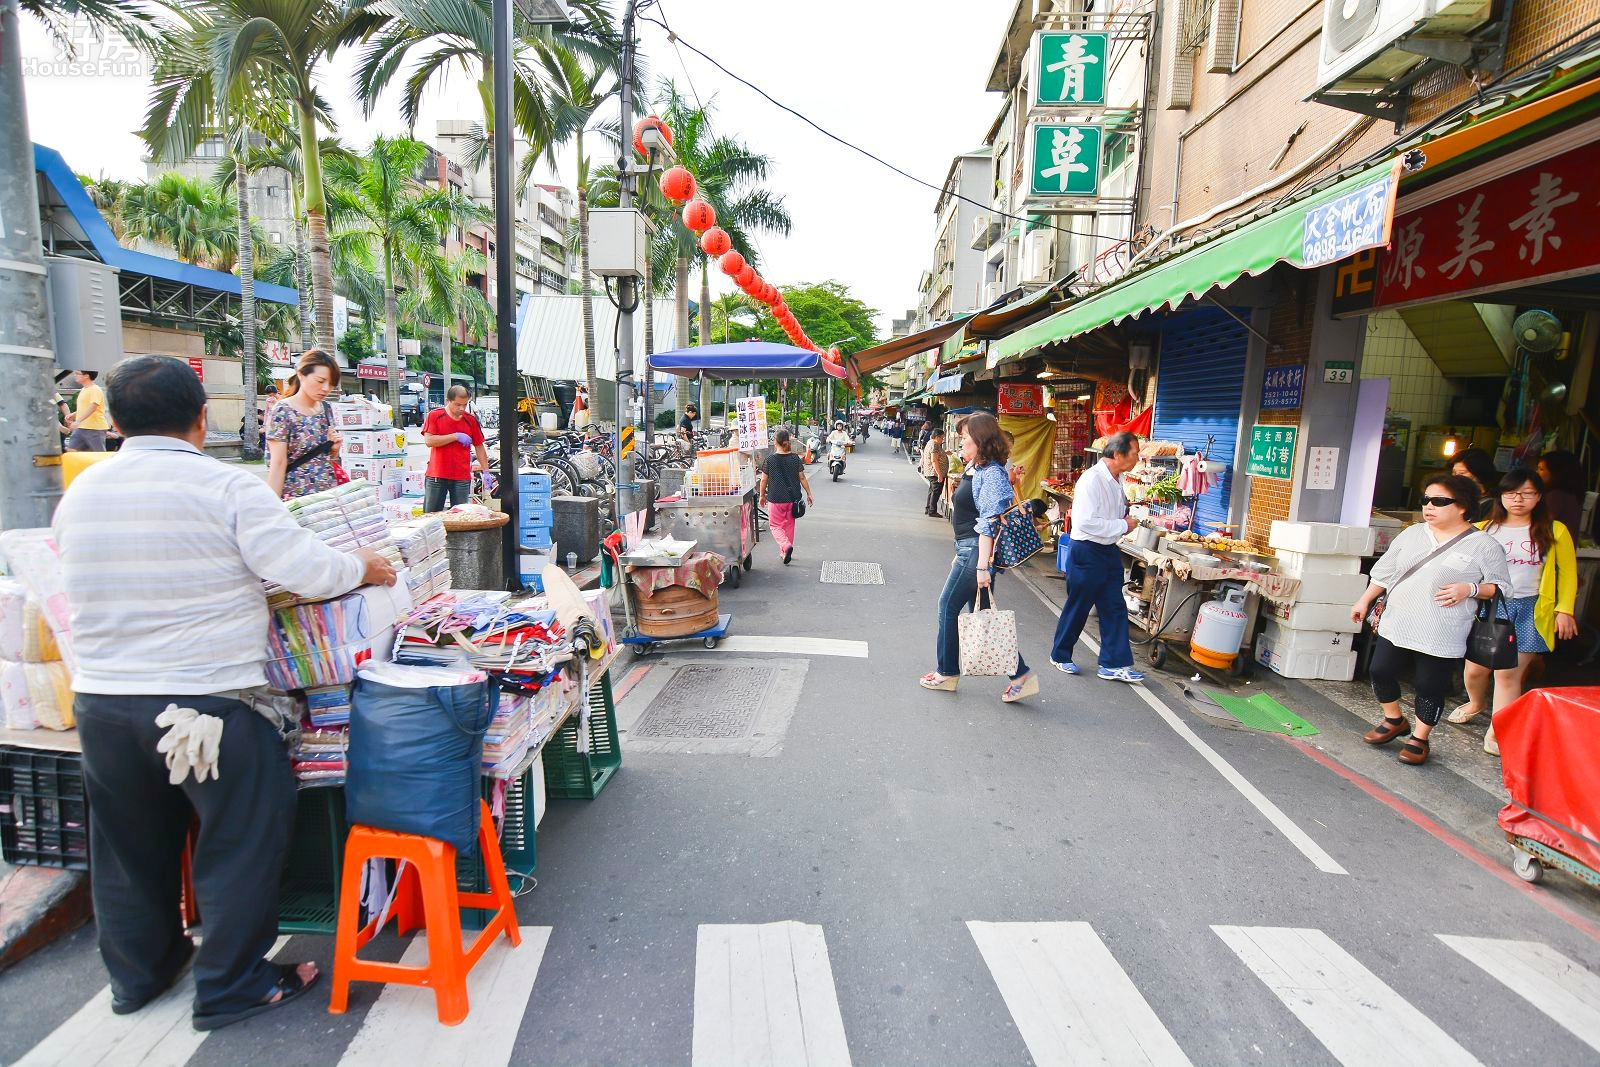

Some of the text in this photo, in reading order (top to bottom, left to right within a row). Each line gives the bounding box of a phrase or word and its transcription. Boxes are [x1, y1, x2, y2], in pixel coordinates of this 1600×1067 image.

[1384, 172, 1600, 291] 源美素
[1329, 370, 1347, 382] 39
[1264, 390, 1299, 399] 2521-1040
[1254, 430, 1293, 444] 民生西路
[740, 441, 749, 449] 20
[750, 439, 759, 448] 20
